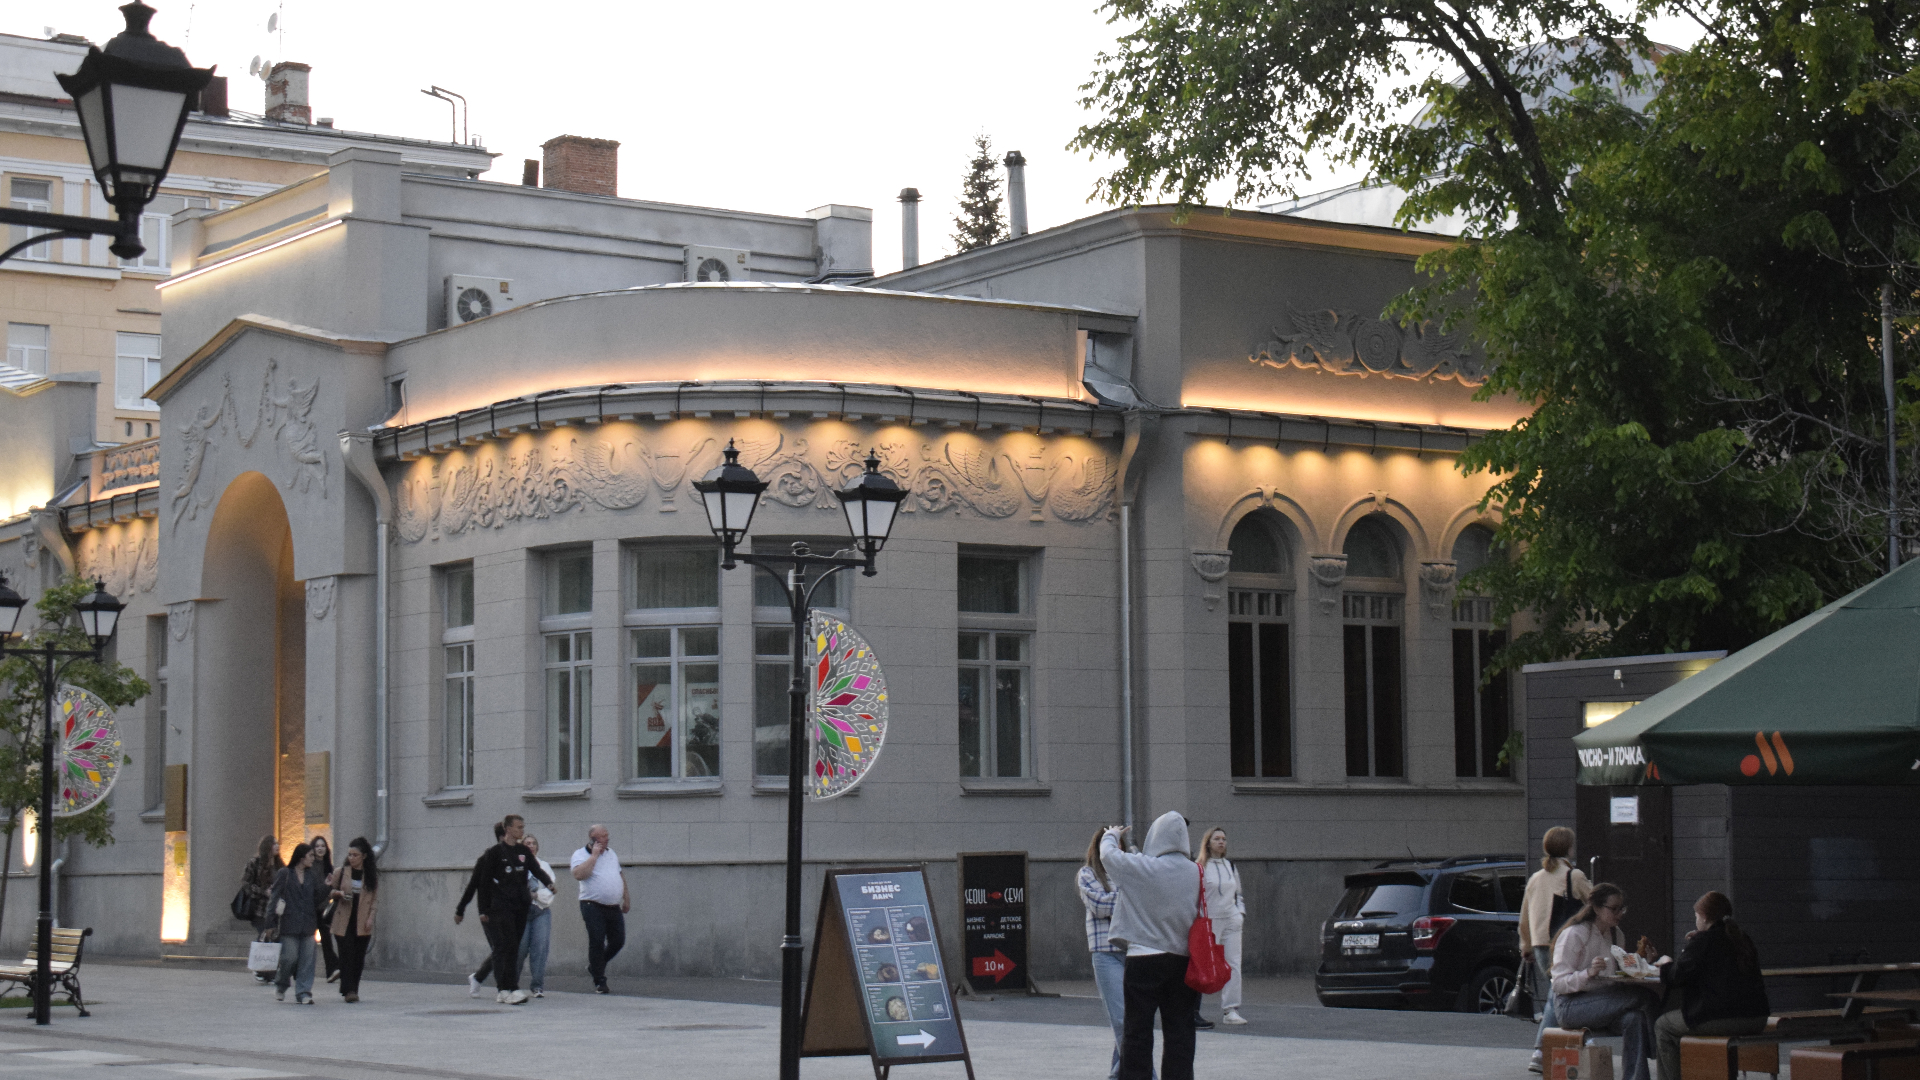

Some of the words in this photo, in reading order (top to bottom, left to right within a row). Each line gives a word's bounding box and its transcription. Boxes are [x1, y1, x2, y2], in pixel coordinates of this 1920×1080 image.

[1615, 746, 1646, 766] ТОЧКА
[861, 884, 901, 894] БИЗНЕС
[965, 889, 987, 904] SEOUL
[1004, 887, 1024, 903] СЕУЛ
[985, 961, 996, 971] 10
